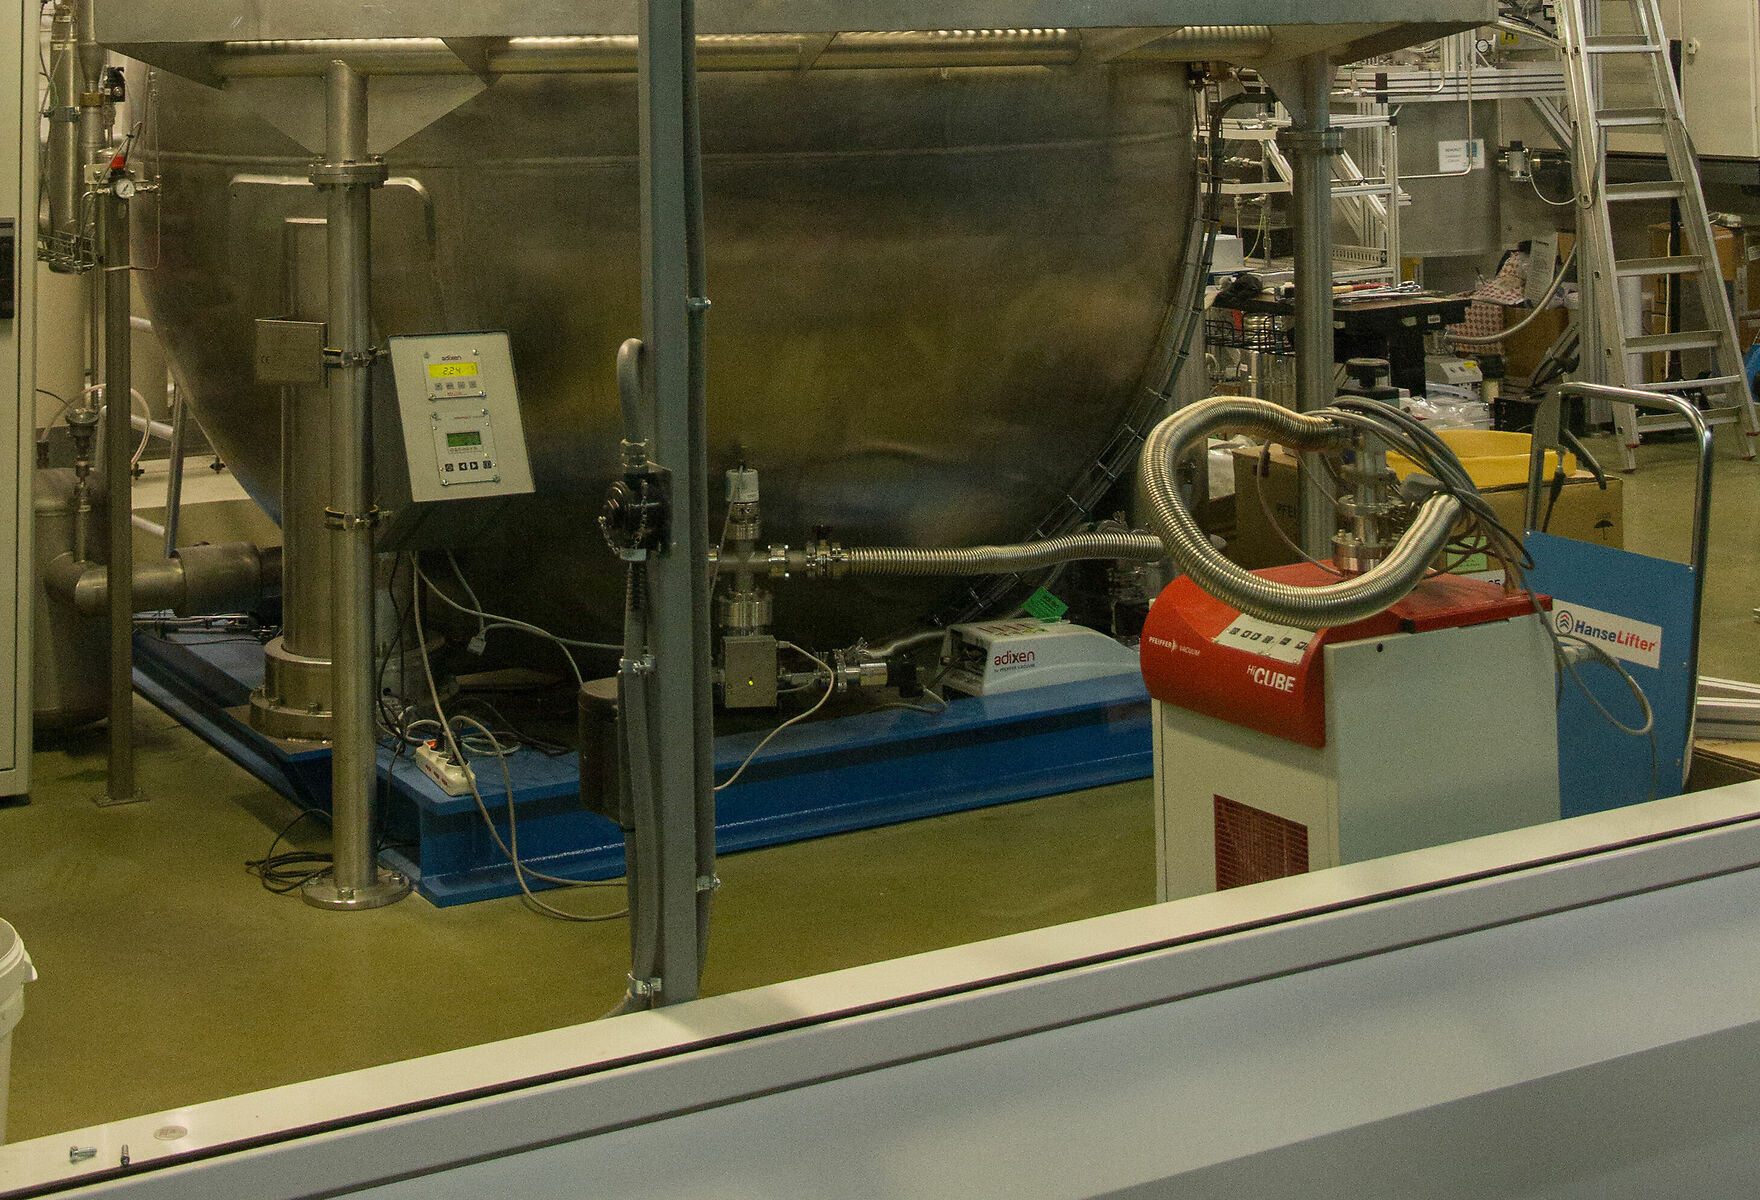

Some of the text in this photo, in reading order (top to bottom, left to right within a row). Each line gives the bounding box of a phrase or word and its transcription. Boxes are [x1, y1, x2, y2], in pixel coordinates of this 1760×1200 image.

[1148, 636, 1201, 657] PFEIFFER VACUUM
[1574, 619, 1656, 653] HanseLifter
[993, 650, 1035, 666] adixen
